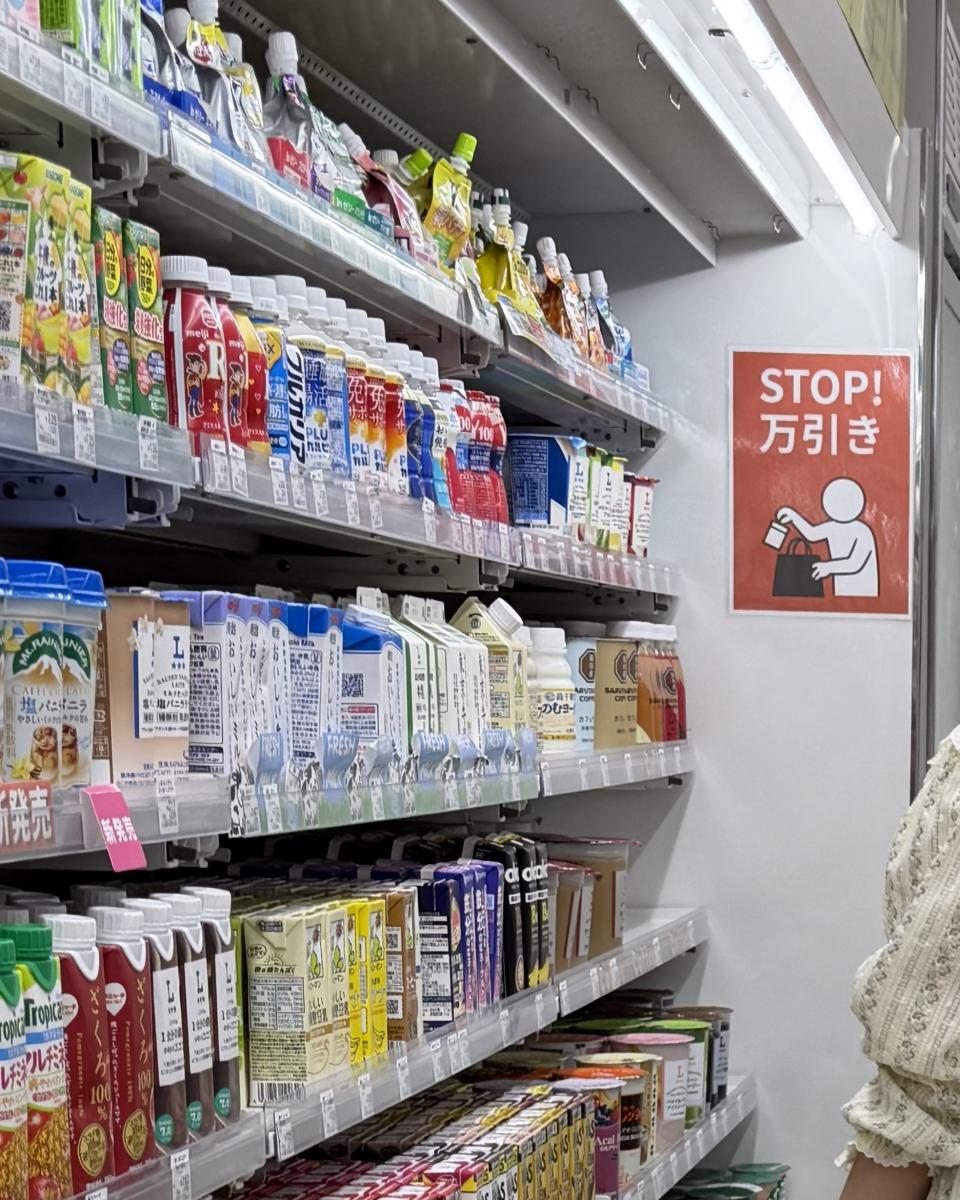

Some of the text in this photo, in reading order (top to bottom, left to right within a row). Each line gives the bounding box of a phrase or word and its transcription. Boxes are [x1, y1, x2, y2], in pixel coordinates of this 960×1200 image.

[760, 368, 882, 407] STOP!
[760, 413, 880, 456] 万引き
[173, 636, 184, 659] L
[100, 815, 138, 845] 新発売
